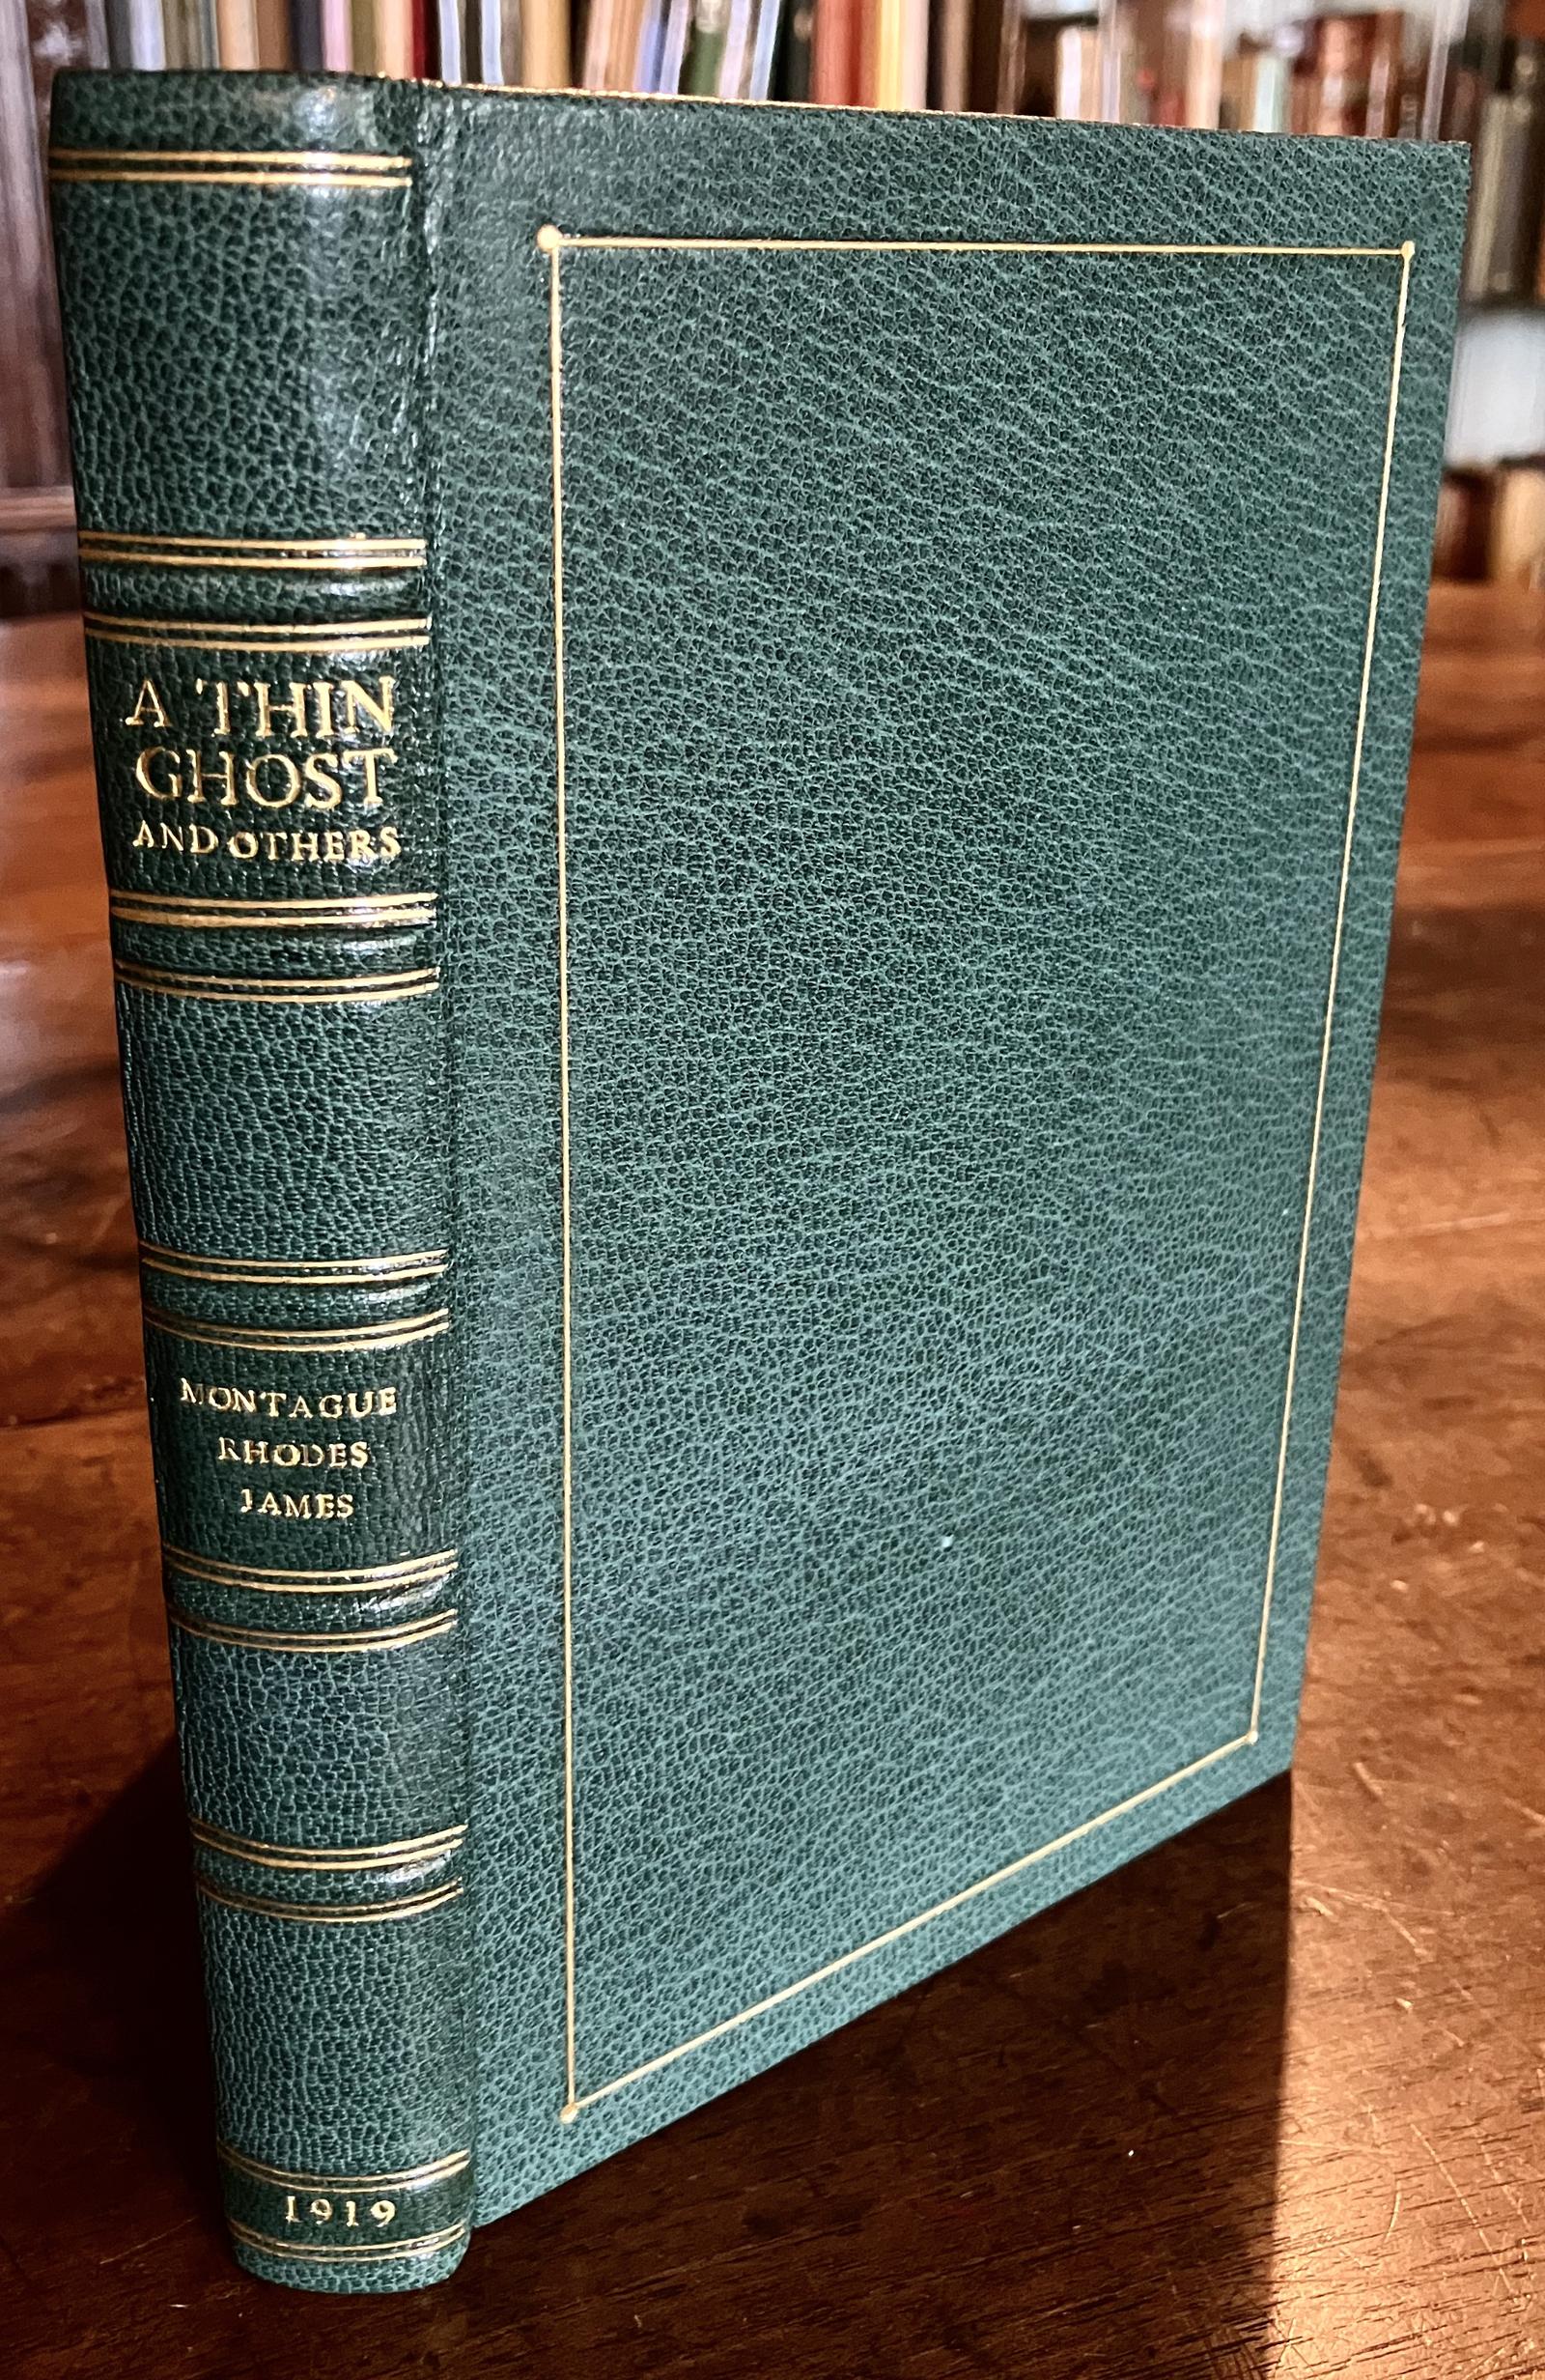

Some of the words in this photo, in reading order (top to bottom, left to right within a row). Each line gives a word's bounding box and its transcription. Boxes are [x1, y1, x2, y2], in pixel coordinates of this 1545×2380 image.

[126, 678, 171, 727] A
[196, 676, 396, 738] THIN
[135, 746, 398, 809] GHOST
[132, 820, 219, 854] AND
[227, 826, 402, 861] OTHERS
[180, 1377, 398, 1419] MONTAGUE
[217, 1436, 371, 1468] RHODES
[240, 1488, 354, 1520] JAMES
[285, 2196, 396, 2227] 1919
